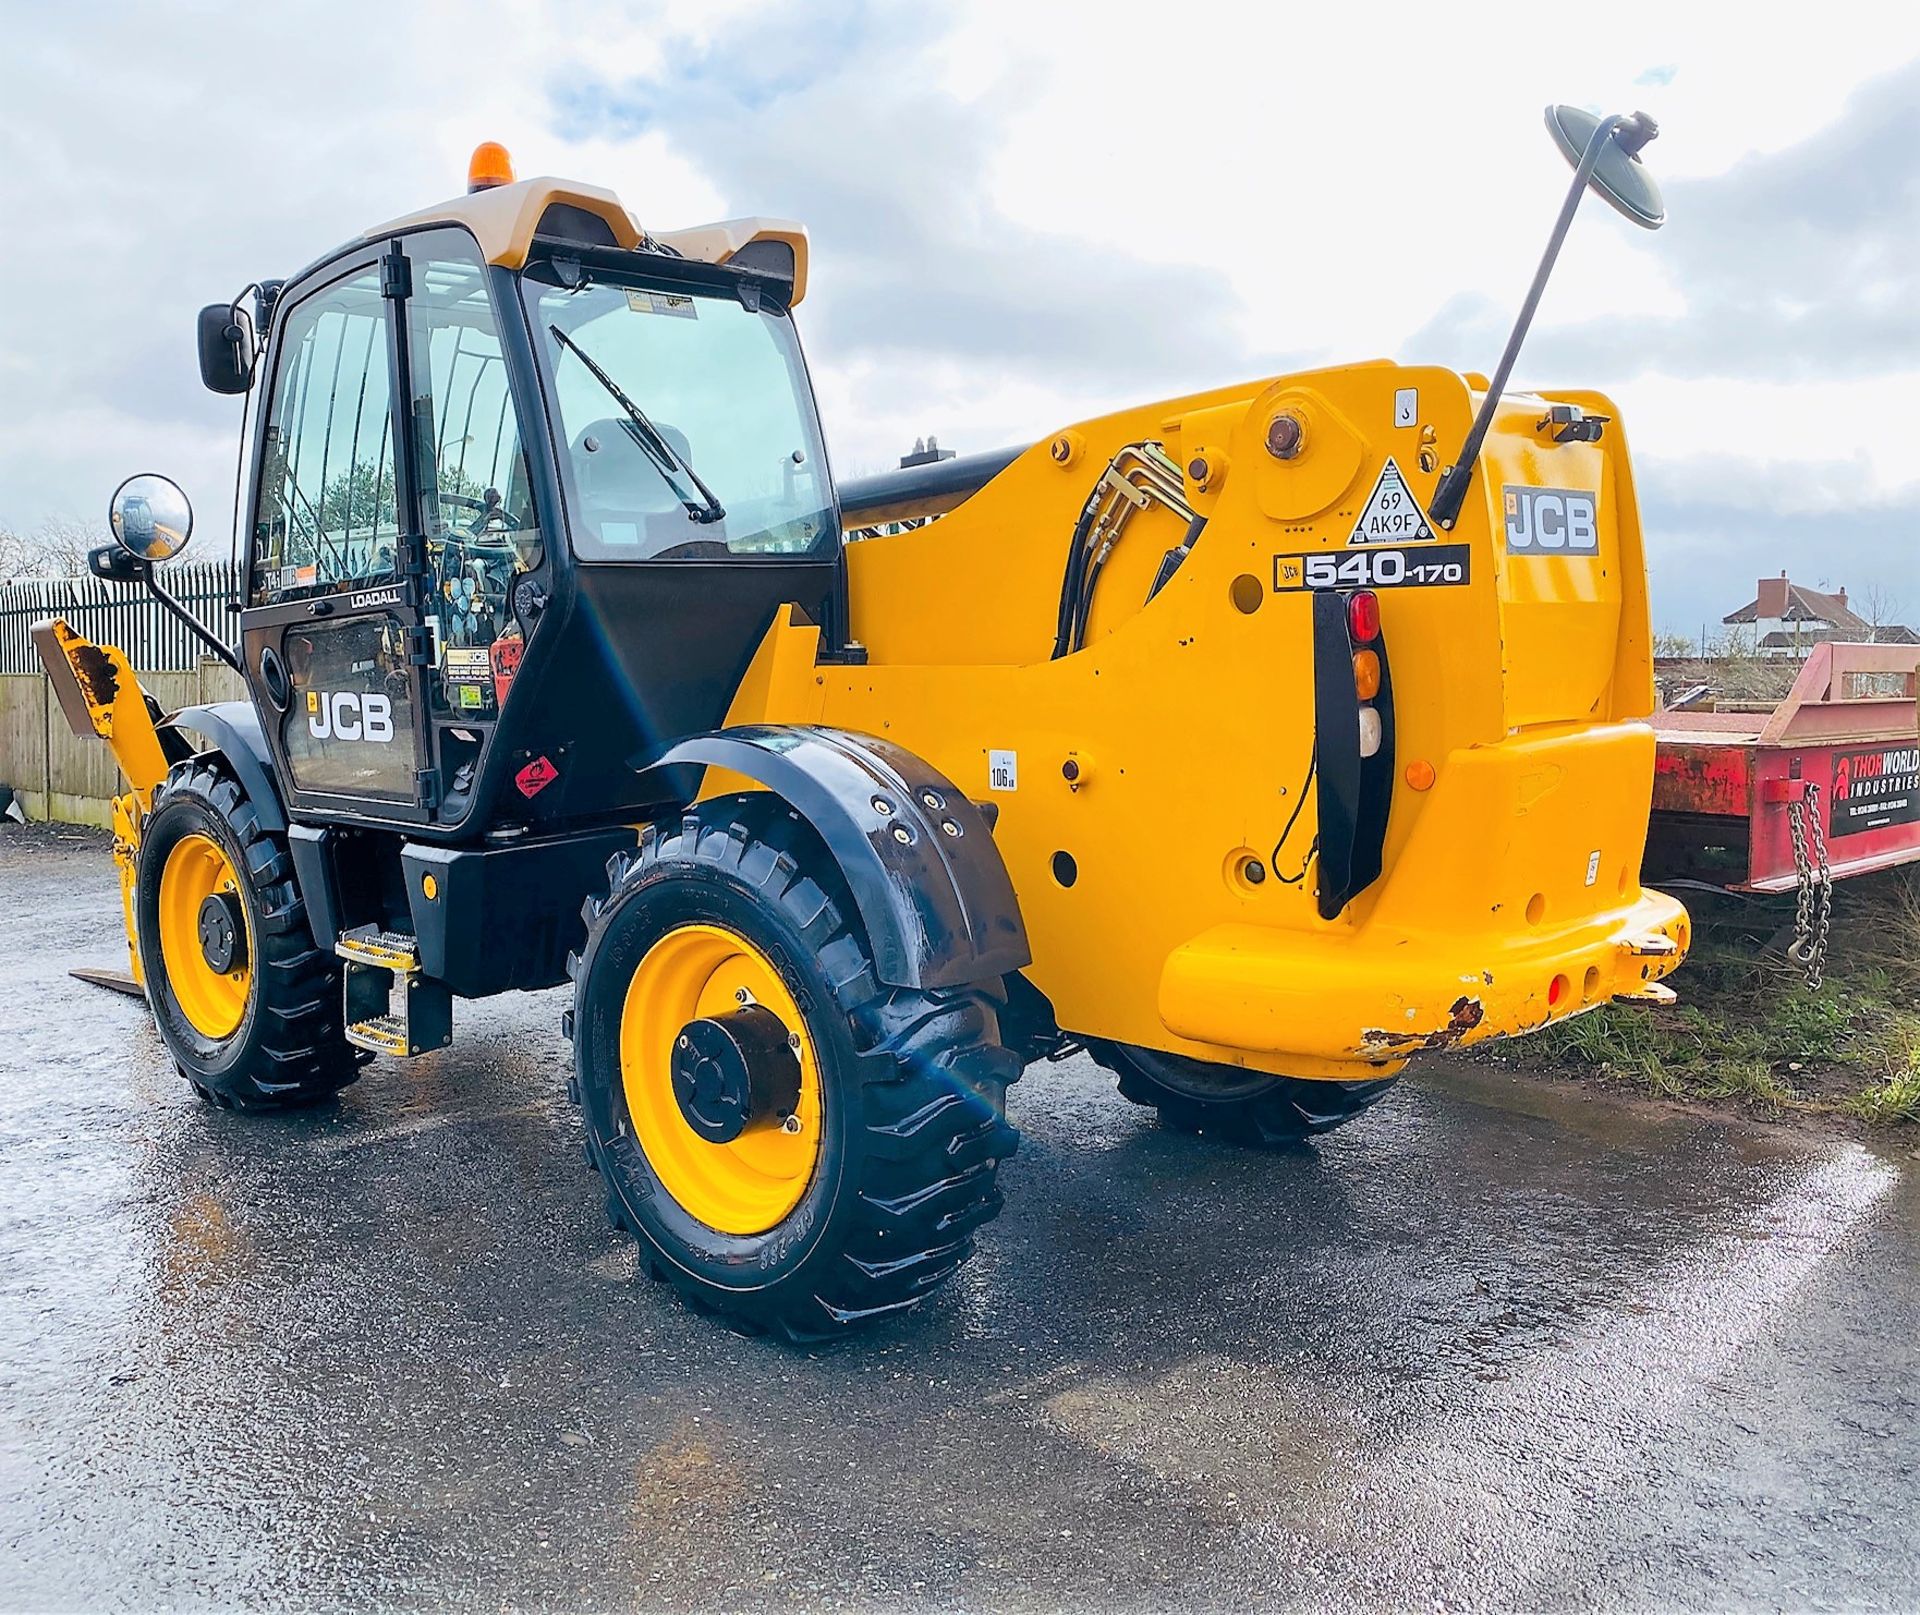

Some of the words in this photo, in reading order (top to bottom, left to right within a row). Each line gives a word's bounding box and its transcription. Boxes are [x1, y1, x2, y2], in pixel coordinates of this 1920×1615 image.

[1381, 492, 1401, 510] 69
[1370, 513, 1415, 534] AK9F
[1507, 494, 1597, 548] JCB
[1305, 551, 1462, 587] 540-170
[351, 589, 401, 609] LOADALL
[308, 691, 394, 743] JCB
[991, 767, 1008, 787] 106
[1850, 774, 1920, 799] INDUSTRIES
